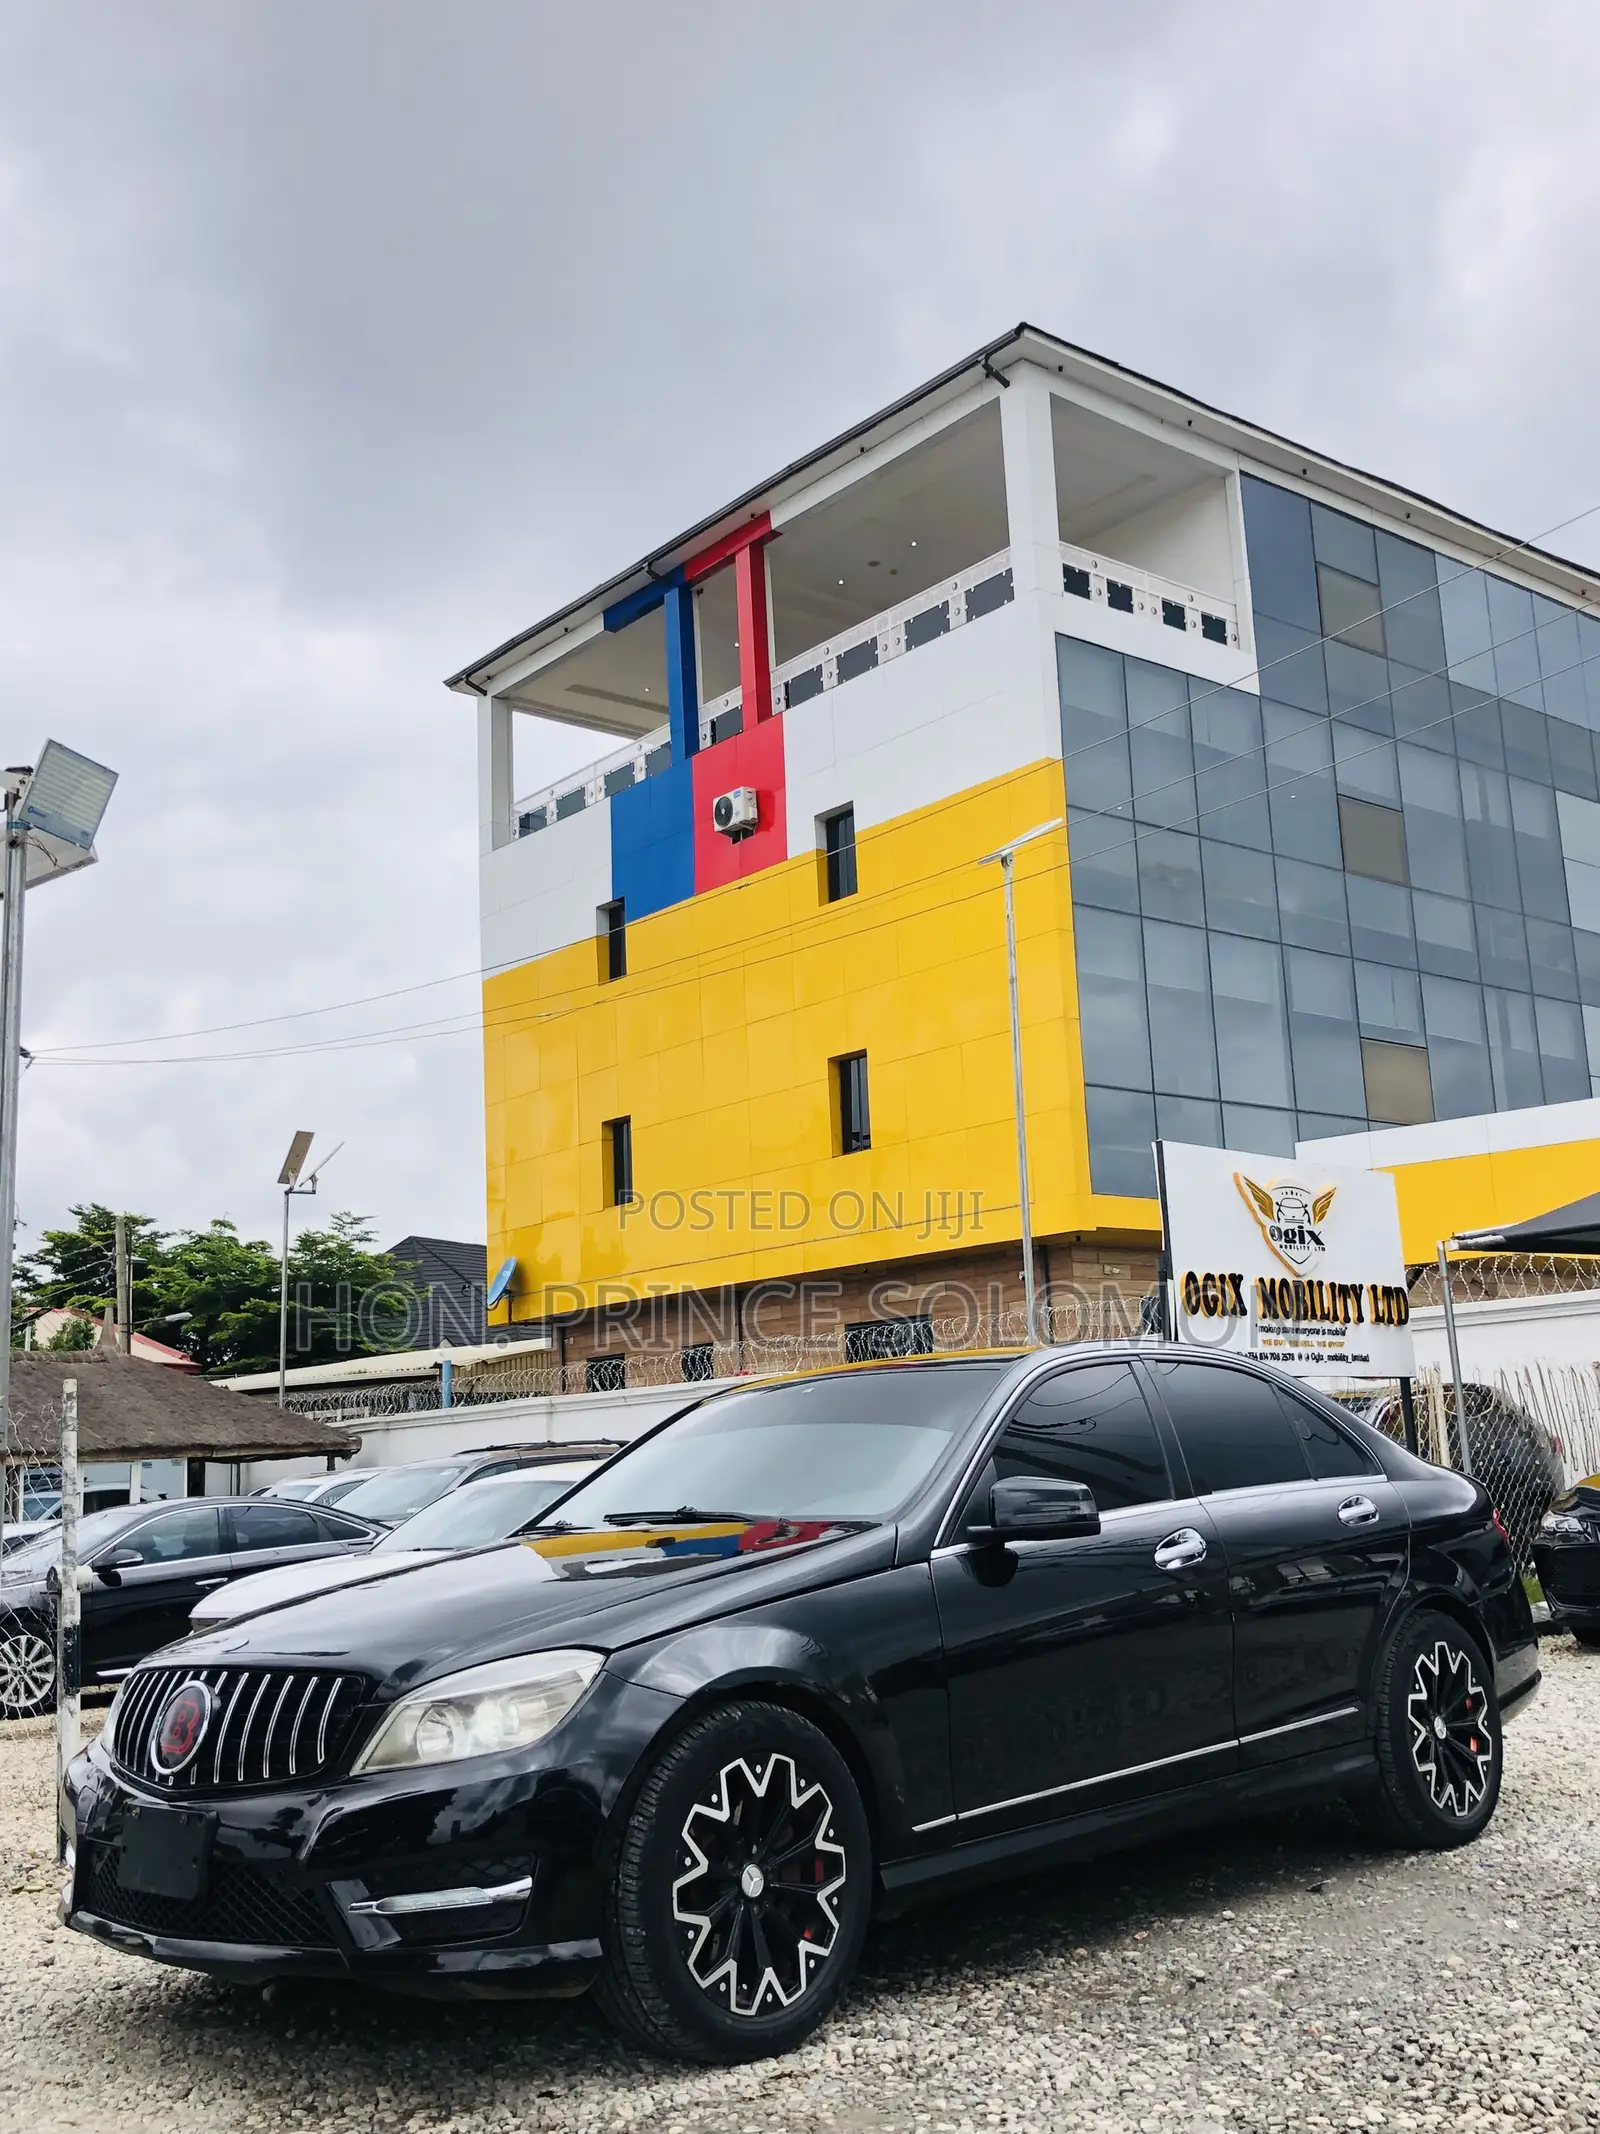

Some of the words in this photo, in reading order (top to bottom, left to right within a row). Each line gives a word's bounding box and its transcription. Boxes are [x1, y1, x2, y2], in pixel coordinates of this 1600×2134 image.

[1180, 1271, 1248, 1317] OGIX
[1255, 1277, 1365, 1325] MOBILITY
[1367, 1284, 1410, 1326] LTD
